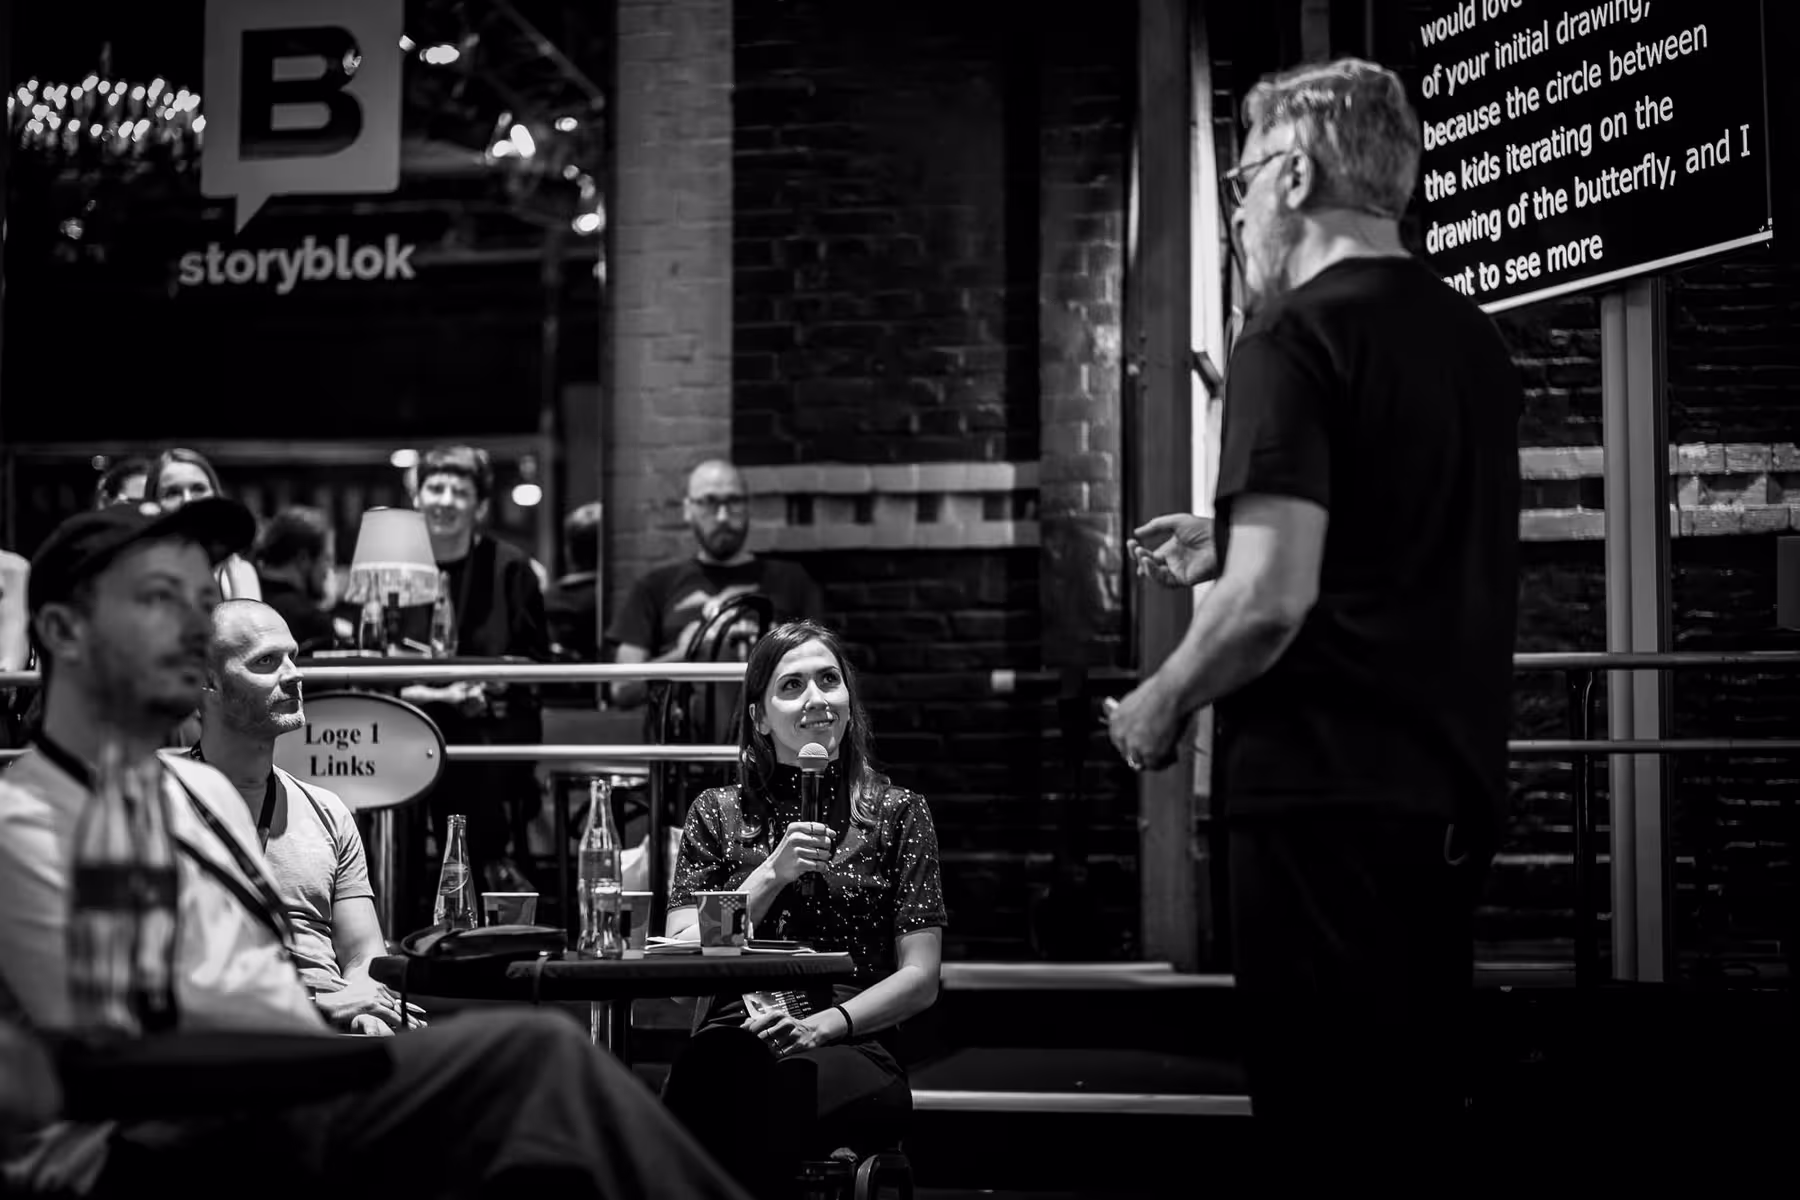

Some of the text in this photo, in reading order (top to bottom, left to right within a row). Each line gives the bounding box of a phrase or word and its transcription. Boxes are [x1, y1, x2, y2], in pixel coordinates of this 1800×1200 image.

[1420, 0, 1476, 48] would
[1422, 0, 1651, 99] of your initial drawing,
[239, 25, 364, 161] B
[1424, 23, 1708, 152] because the circle between
[1424, 94, 1674, 203] the kids iterating on the
[1425, 123, 1751, 255] drawing of the butterfly, and I
[179, 234, 416, 295] storyblok
[1478, 261, 1501, 292] to
[1504, 251, 1542, 285] see
[1546, 234, 1604, 273] more
[304, 722, 380, 750] Loge 1
[310, 755, 376, 777] Links
